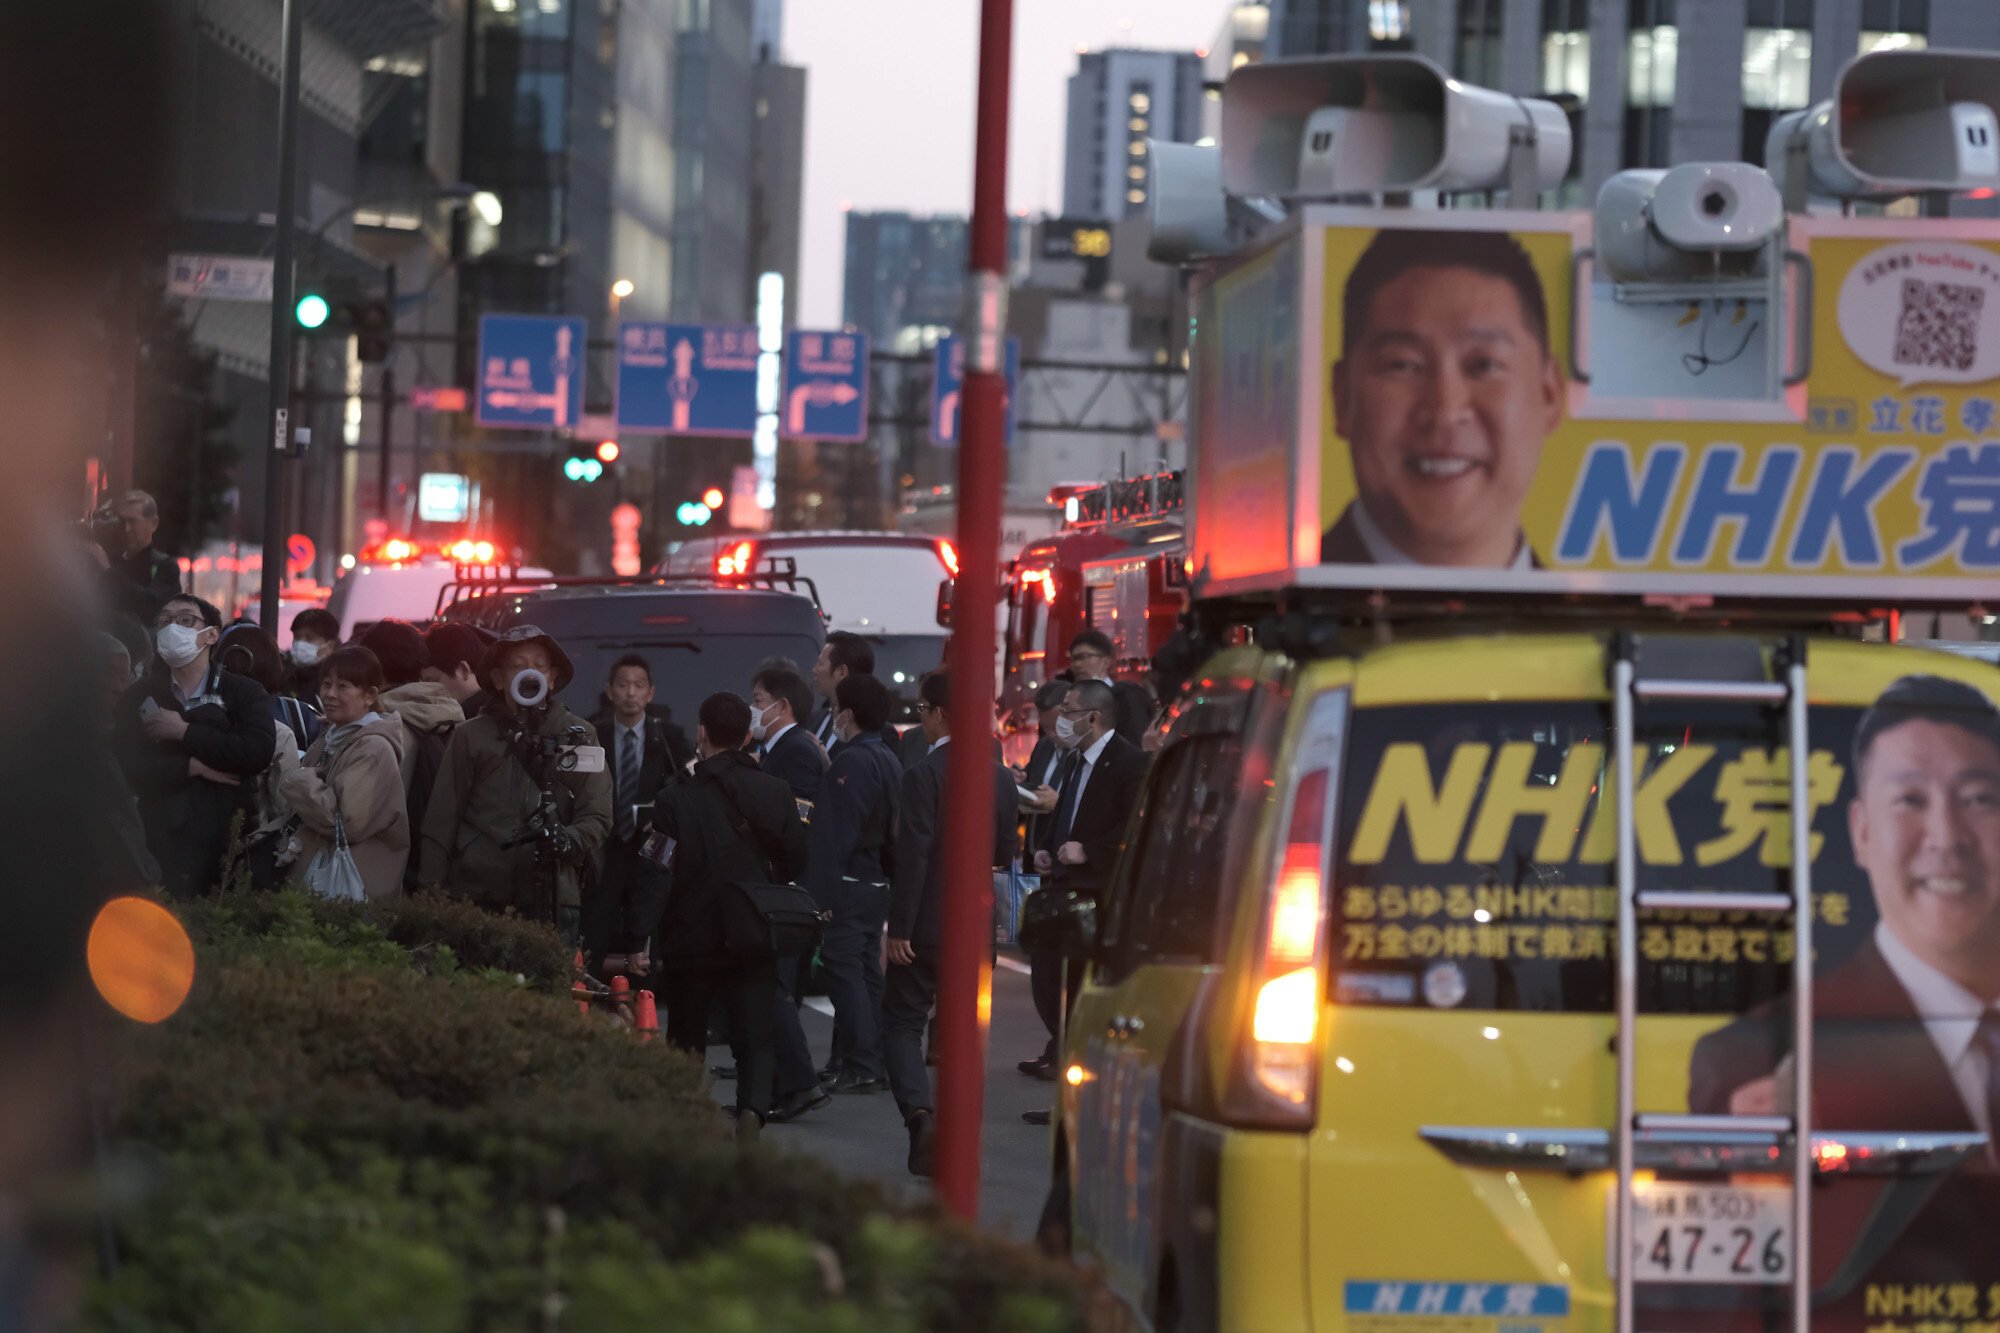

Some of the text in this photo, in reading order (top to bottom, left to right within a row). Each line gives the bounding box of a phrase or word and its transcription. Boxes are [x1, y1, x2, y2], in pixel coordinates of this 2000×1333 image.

[1558, 442, 2000, 567] NHK党
[1348, 743, 1844, 868] NHK党
[1651, 1226, 1784, 1275] 47-26
[1373, 1284, 1538, 1315] NHK党
[1864, 1282, 1979, 1319] NHK党
